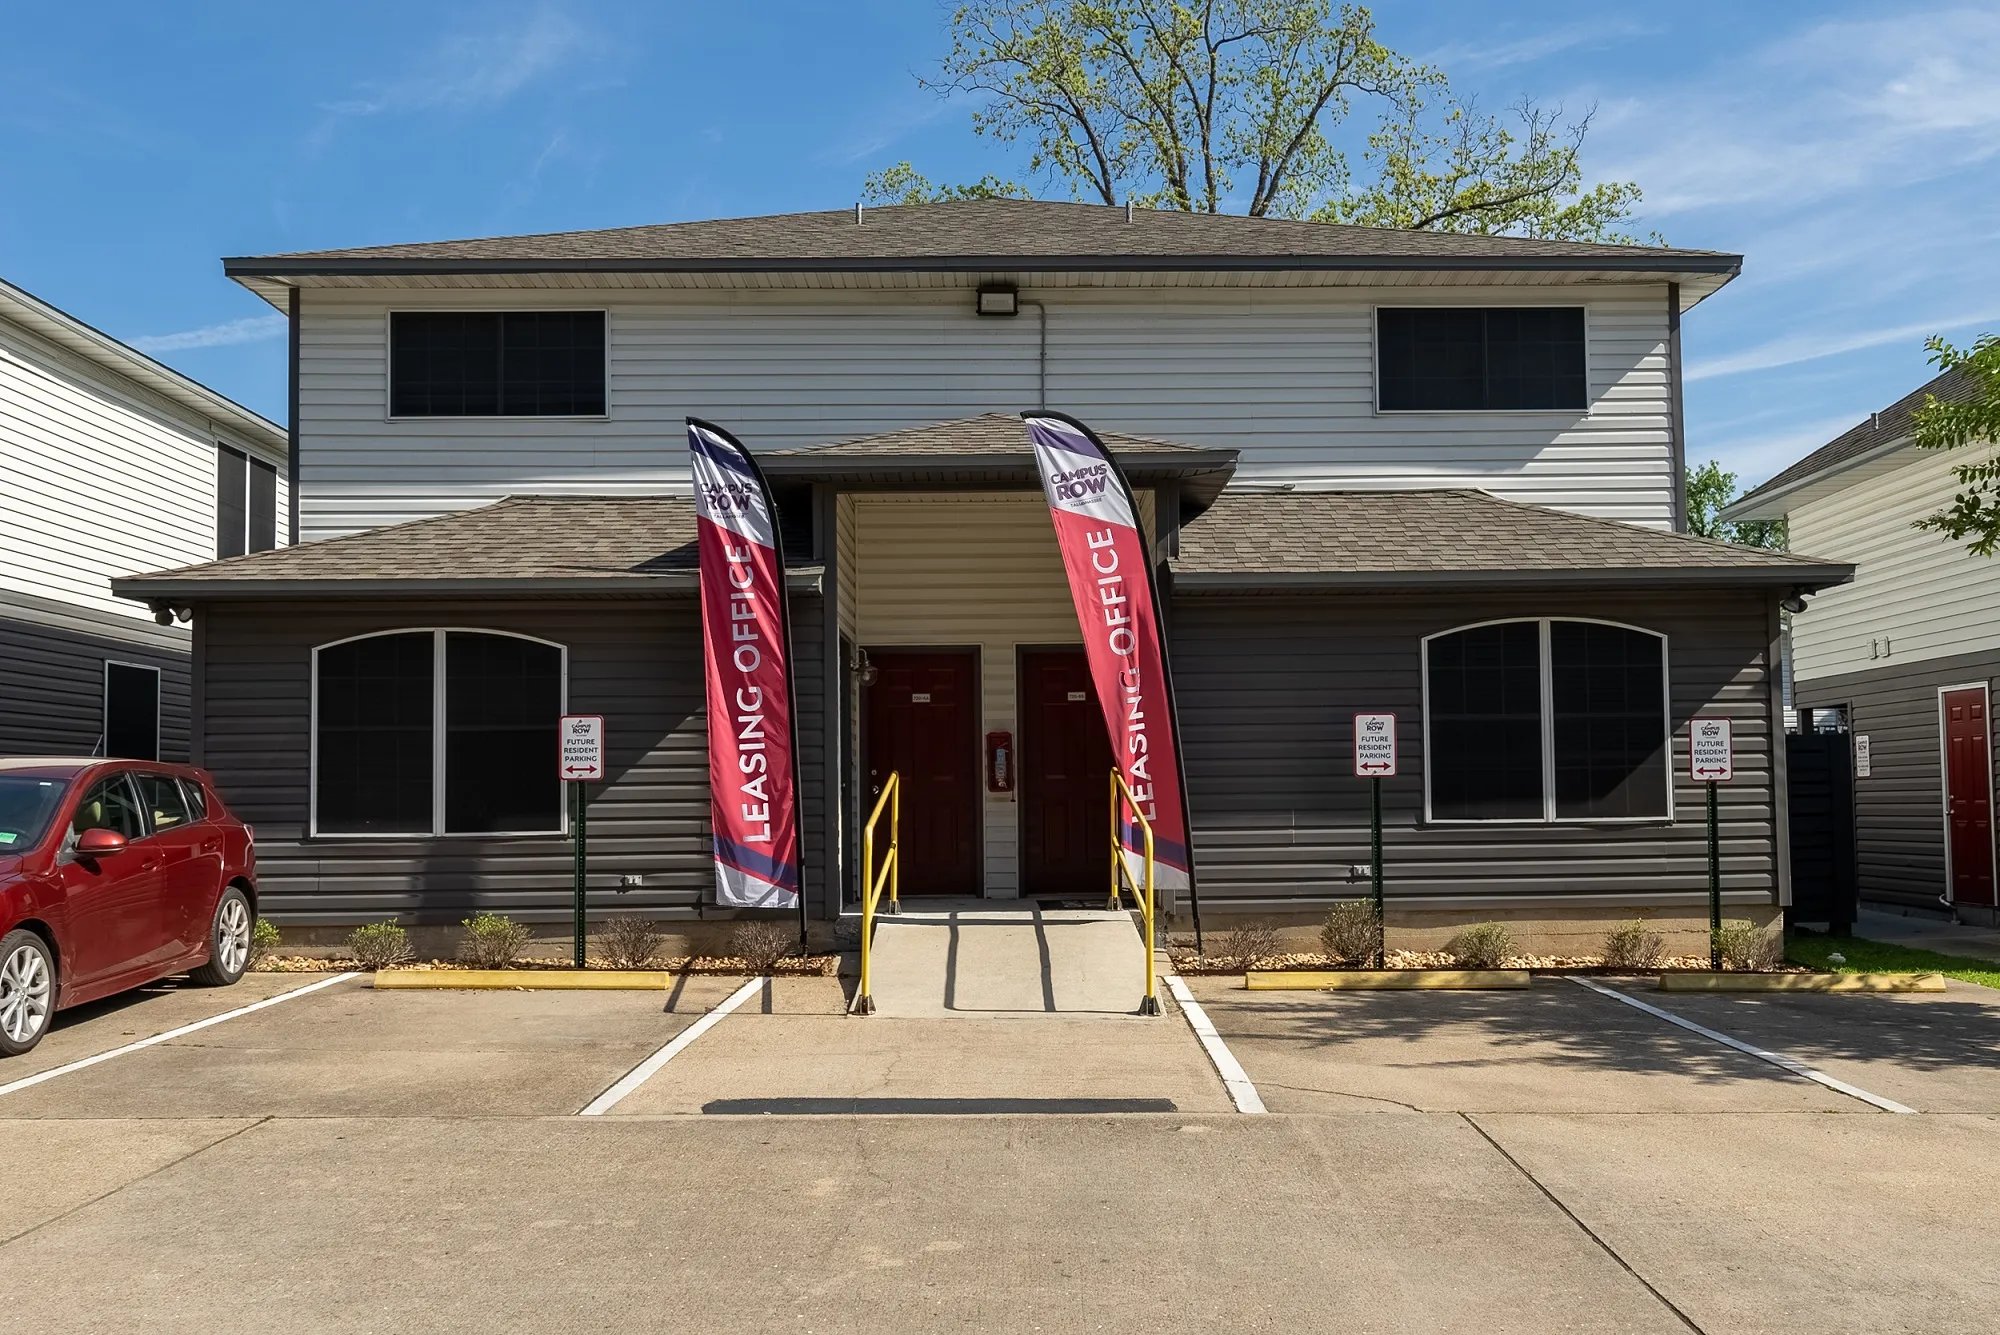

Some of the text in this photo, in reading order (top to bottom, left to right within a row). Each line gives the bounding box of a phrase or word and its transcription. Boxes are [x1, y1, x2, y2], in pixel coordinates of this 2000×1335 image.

[1050, 464, 1107, 485] CAMPUS
[700, 483, 753, 494] CAMPUS
[1056, 475, 1107, 500] ROW
[705, 495, 751, 511] ROW
[725, 544, 760, 673] OFFICE
[1086, 528, 1156, 823] LEASING OFFICE
[737, 687, 772, 842] LEASING
